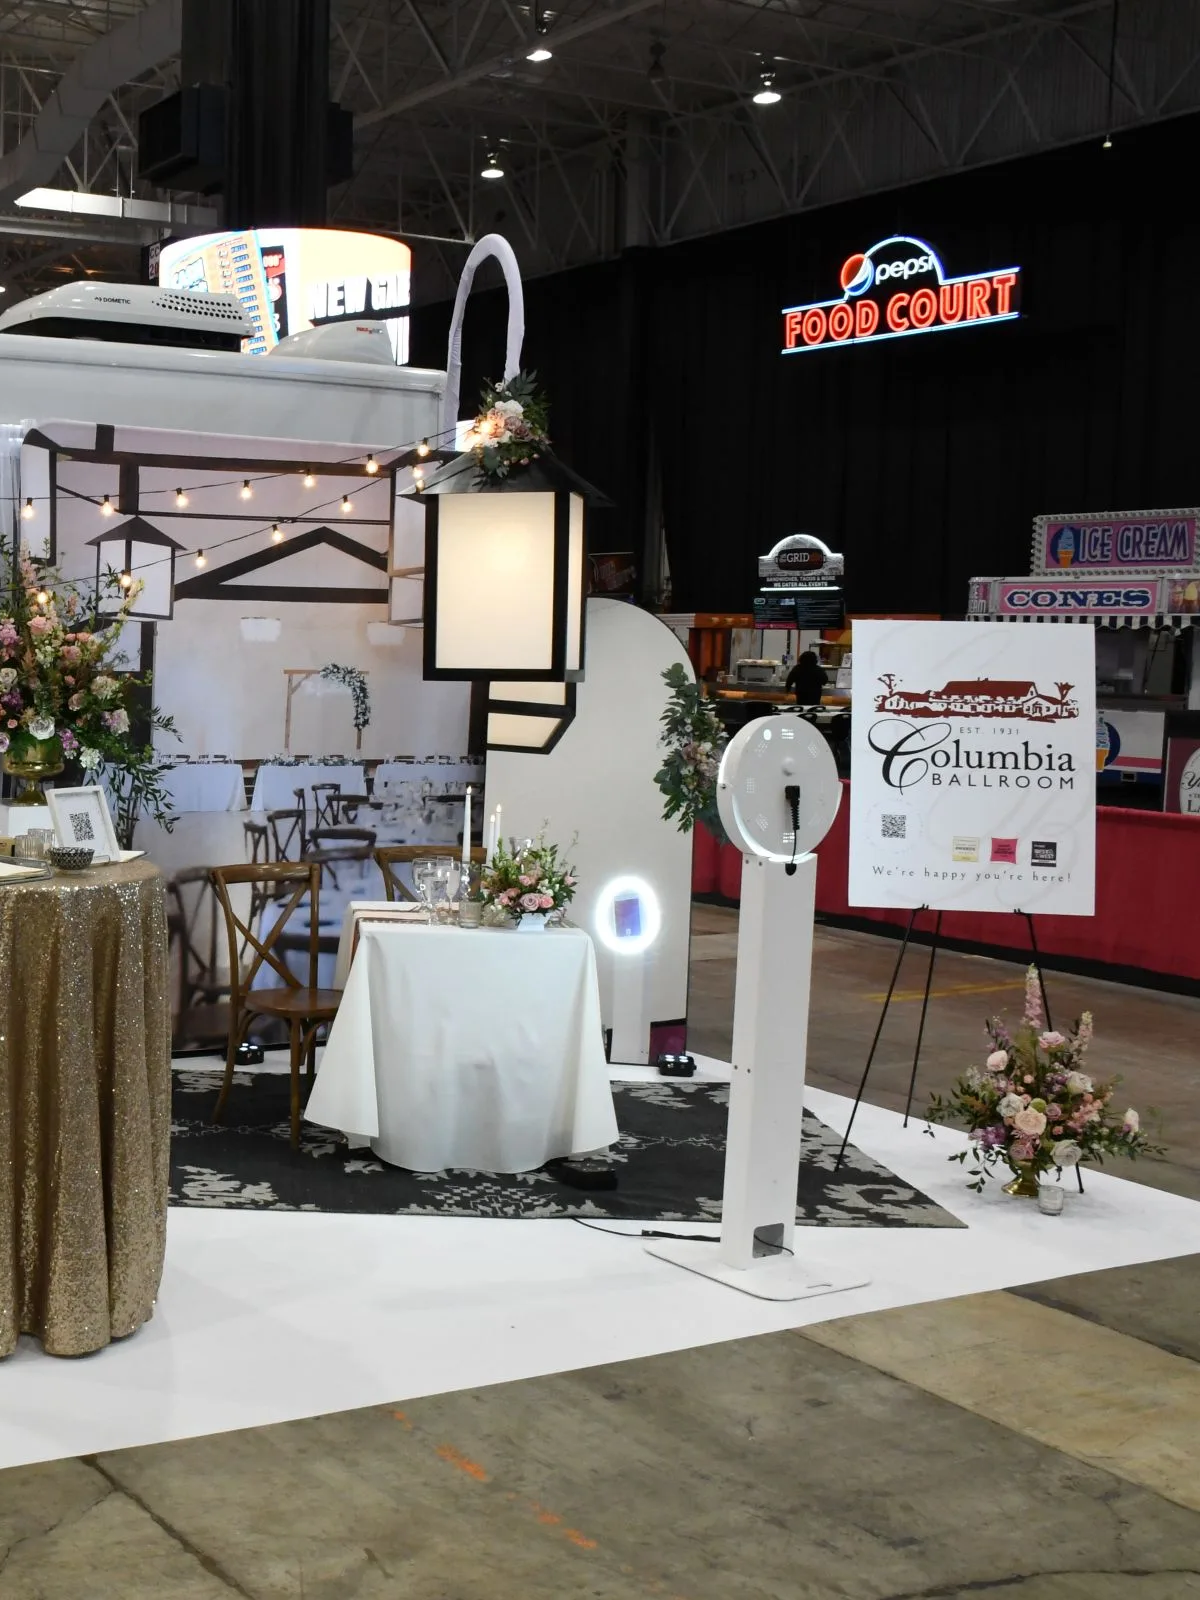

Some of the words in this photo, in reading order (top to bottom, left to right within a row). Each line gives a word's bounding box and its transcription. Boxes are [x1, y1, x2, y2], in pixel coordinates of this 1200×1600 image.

[150, 262, 160, 276] 20
[875, 254, 936, 286] pepsi
[103, 297, 131, 305] DOMETIC
[306, 275, 367, 319] NEW
[785, 300, 879, 349] FOOD
[886, 273, 1016, 332] COURT
[1079, 525, 1113, 562] ICE
[1117, 521, 1189, 561] CREAM
[786, 552, 810, 563] GRID
[1005, 587, 1151, 609] CONES
[960, 726, 984, 735] EST.
[993, 727, 1020, 736] 1931
[867, 718, 1076, 796] Columbia
[932, 773, 1074, 790] BALLROOM
[872, 865, 915, 877] We're
[924, 867, 966, 881] happy
[976, 870, 1023, 882] you're
[1032, 869, 1071, 882] here!
